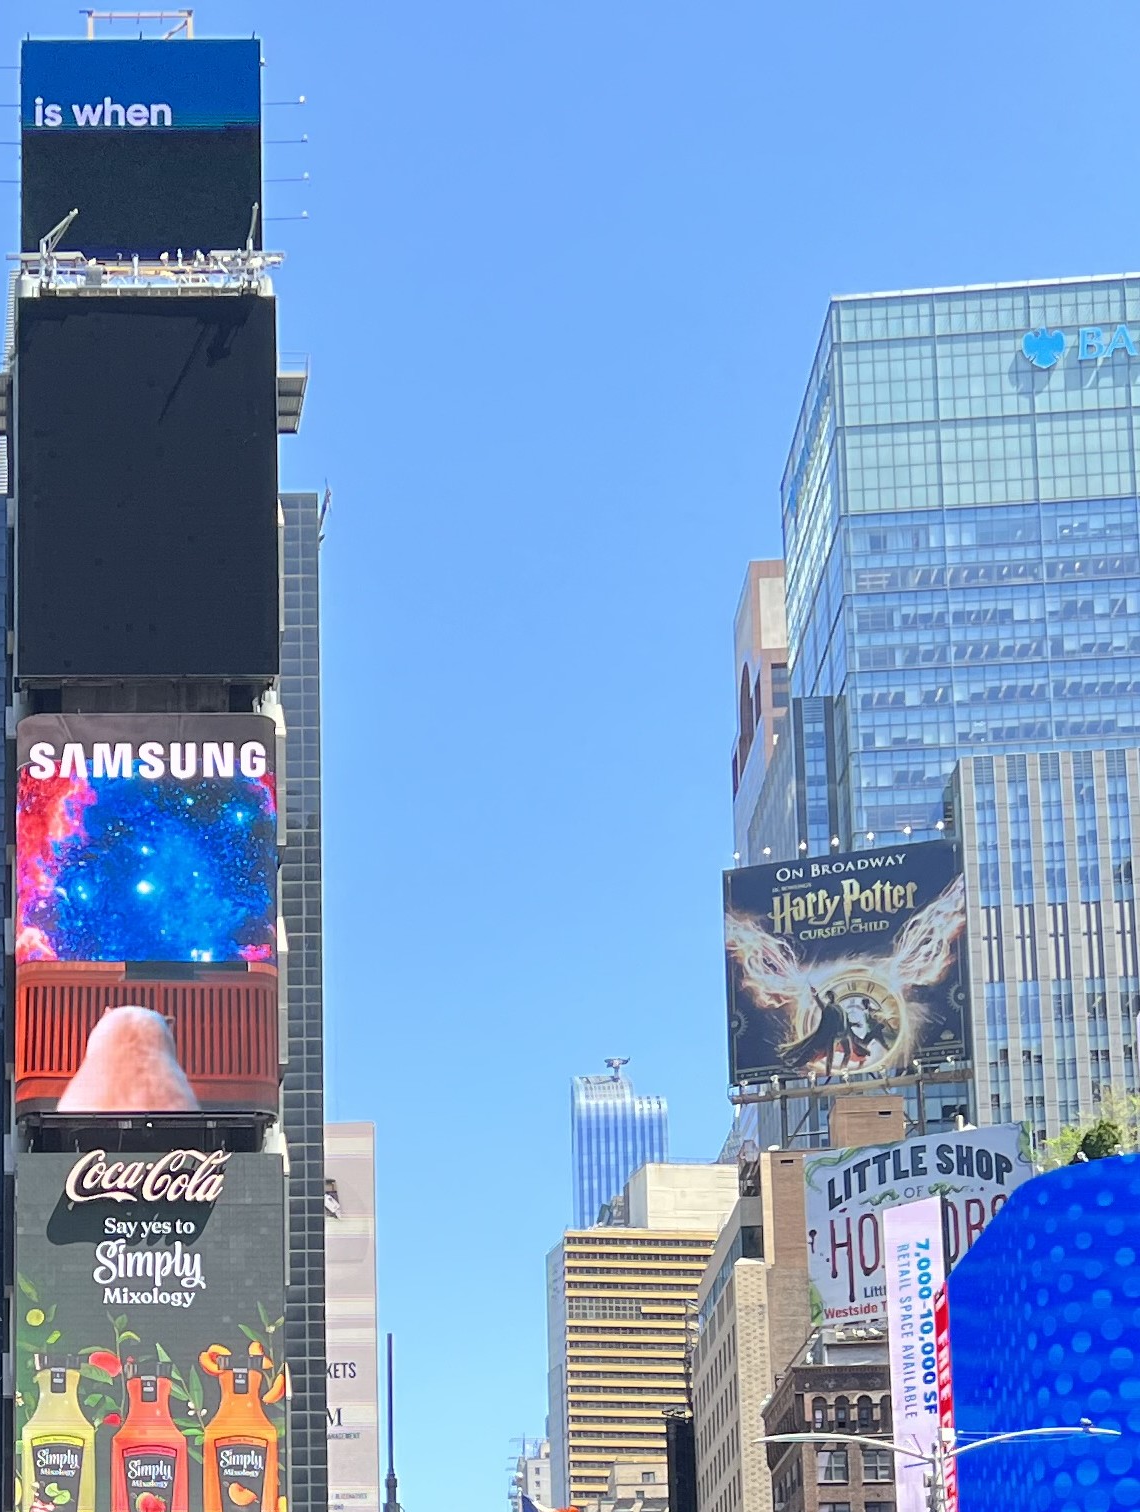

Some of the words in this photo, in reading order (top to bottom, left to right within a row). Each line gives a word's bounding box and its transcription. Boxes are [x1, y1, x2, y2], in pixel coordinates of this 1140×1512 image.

[34, 96, 63, 127] is
[71, 96, 173, 127] when
[29, 742, 266, 779] SAMSUNG
[776, 867, 804, 883] ON
[810, 853, 907, 878] BROADWAY
[767, 888, 841, 935] Harry
[840, 878, 918, 929] Potter
[799, 925, 847, 941] CURSED
[849, 920, 890, 934] CHILD
[65, 1148, 232, 1204] Coca-Cola
[827, 1144, 928, 1211] LITTLE
[935, 1143, 1013, 1186] SHOP
[904, 1186, 924, 1199] OF
[103, 1217, 137, 1238] Say
[140, 1221, 165, 1238] yes
[166, 1218, 196, 1235] to
[93, 1238, 207, 1290] Simply
[897, 1243, 911, 1290] RETAIL
[102, 1286, 196, 1309] Mixology
[824, 1302, 878, 1320] Westside
[899, 1295, 914, 1338] SPACE
[902, 1344, 918, 1419] AVAILABLE
[924, 1391, 938, 1415] SF
[35, 1449, 80, 1469] Simply
[127, 1460, 173, 1481] Simply
[219, 1449, 265, 1470] Simply
